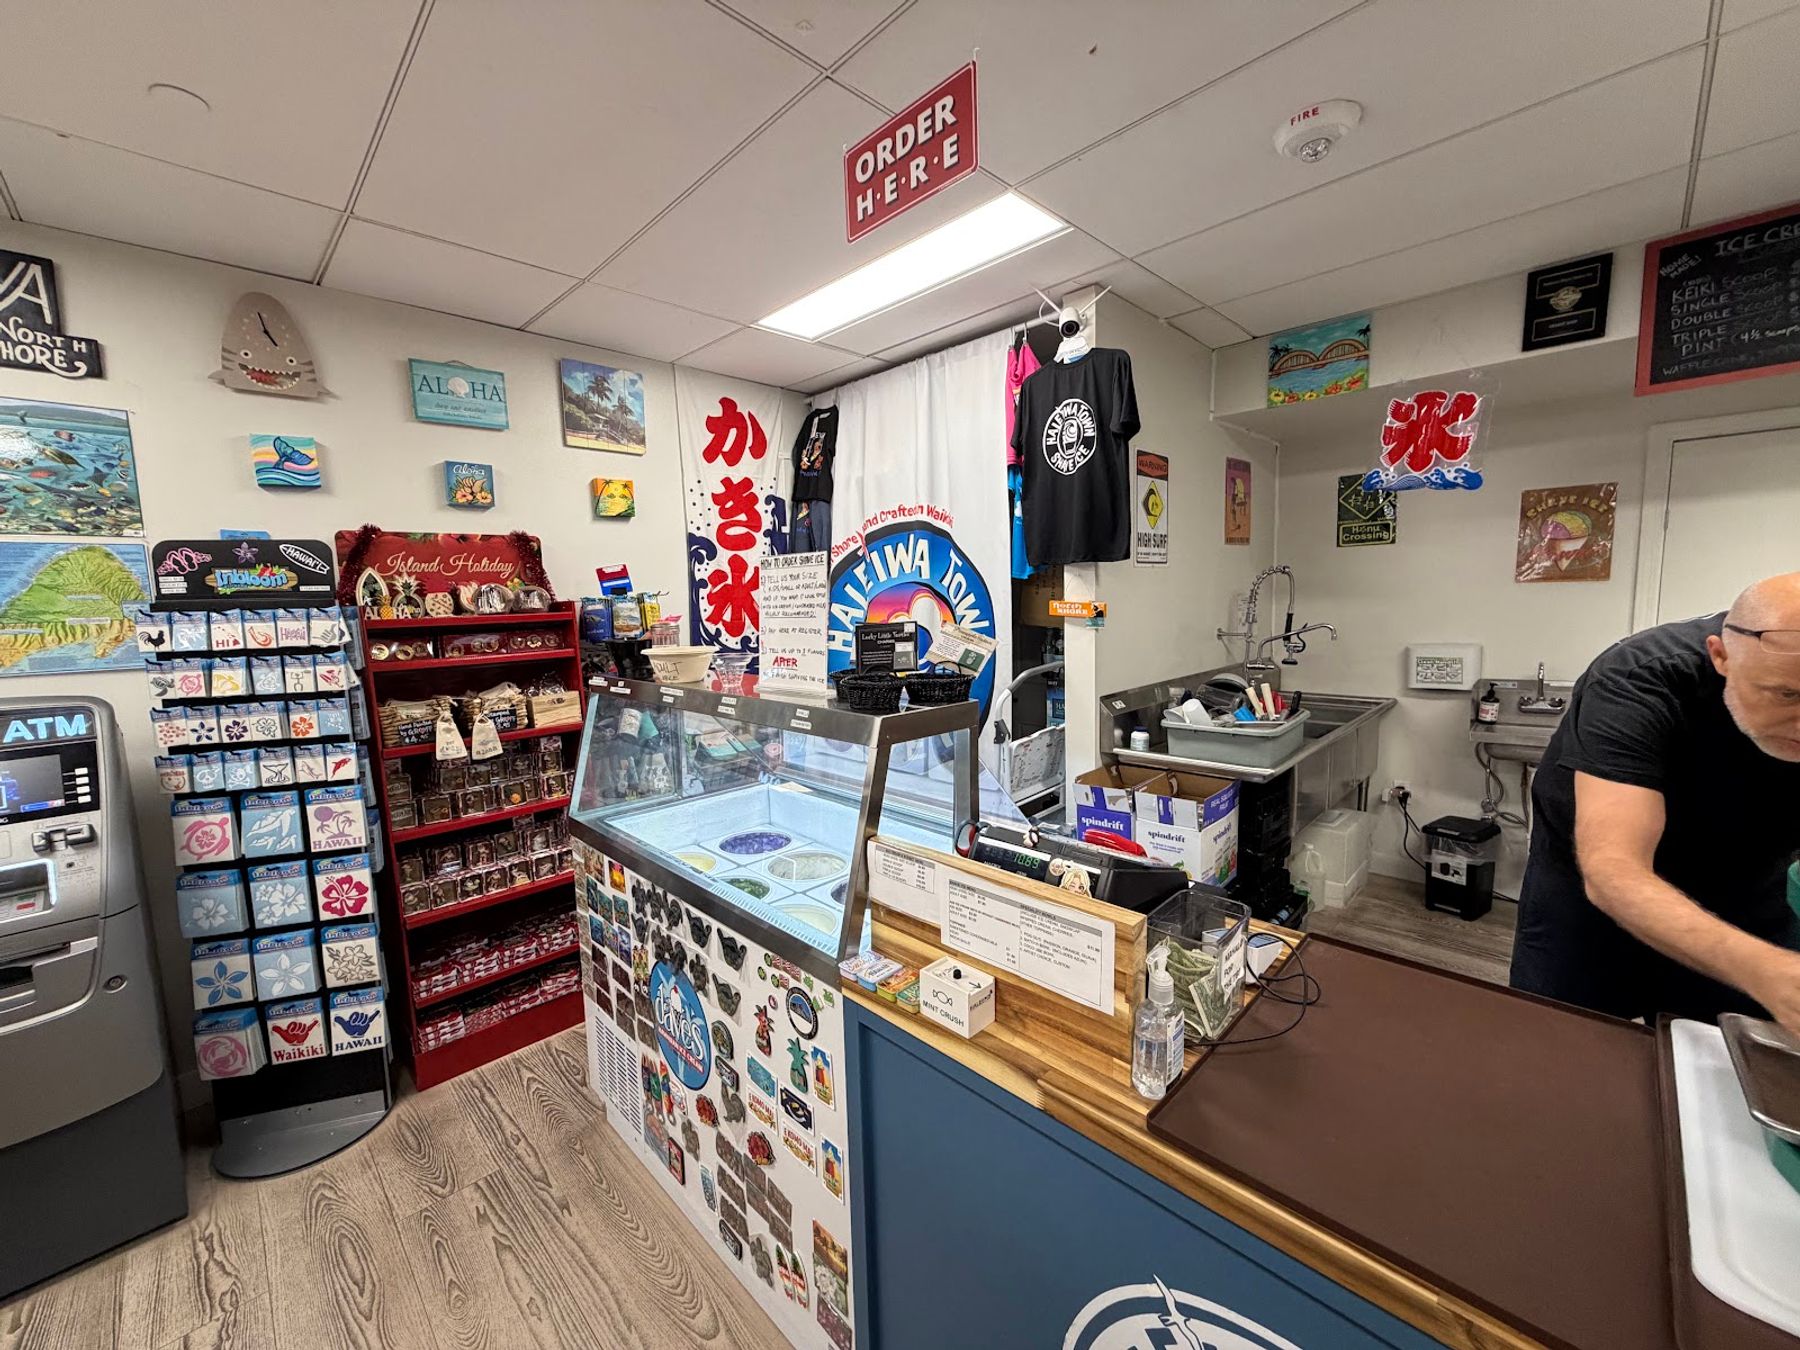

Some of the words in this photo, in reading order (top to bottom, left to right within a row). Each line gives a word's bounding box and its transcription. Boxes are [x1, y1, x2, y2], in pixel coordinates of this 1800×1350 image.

[1290, 106, 1320, 126] FIRE
[854, 95, 957, 184] ORDER
[1715, 233, 1758, 257] ICE
[1763, 220, 1800, 243] CRE
[1672, 282, 1715, 304] KEIKI
[1670, 293, 1731, 316] SINGLE
[1671, 307, 1732, 330] DOUBLE
[1671, 325, 1728, 345] TRIPLE
[1681, 337, 1727, 357] PINT
[0, 341, 87, 378] HORE
[453, 463, 485, 476] Aloha
[1138, 459, 1168, 474] WARNING
[702, 396, 768, 638] かき氷
[1343, 531, 1390, 541] Crossing
[1352, 525, 1381, 533] Honu
[832, 535, 859, 558] Shore
[1137, 532, 1152, 548] HIGH
[1152, 534, 1168, 549] SURF
[375, 551, 441, 577] Island
[440, 552, 515, 579] Holiday
[939, 548, 991, 629] TOW
[772, 655, 798, 668] AFTER
[2, 713, 87, 744] ATM
[1081, 815, 1124, 832] spindrift
[312, 836, 363, 851] HAWAII
[1147, 829, 1186, 844] spindrift
[922, 999, 939, 1015] MINT
[939, 1007, 965, 1028] CRUSH
[273, 1044, 325, 1063] Waikiki
[334, 1036, 383, 1052] HAWAII
